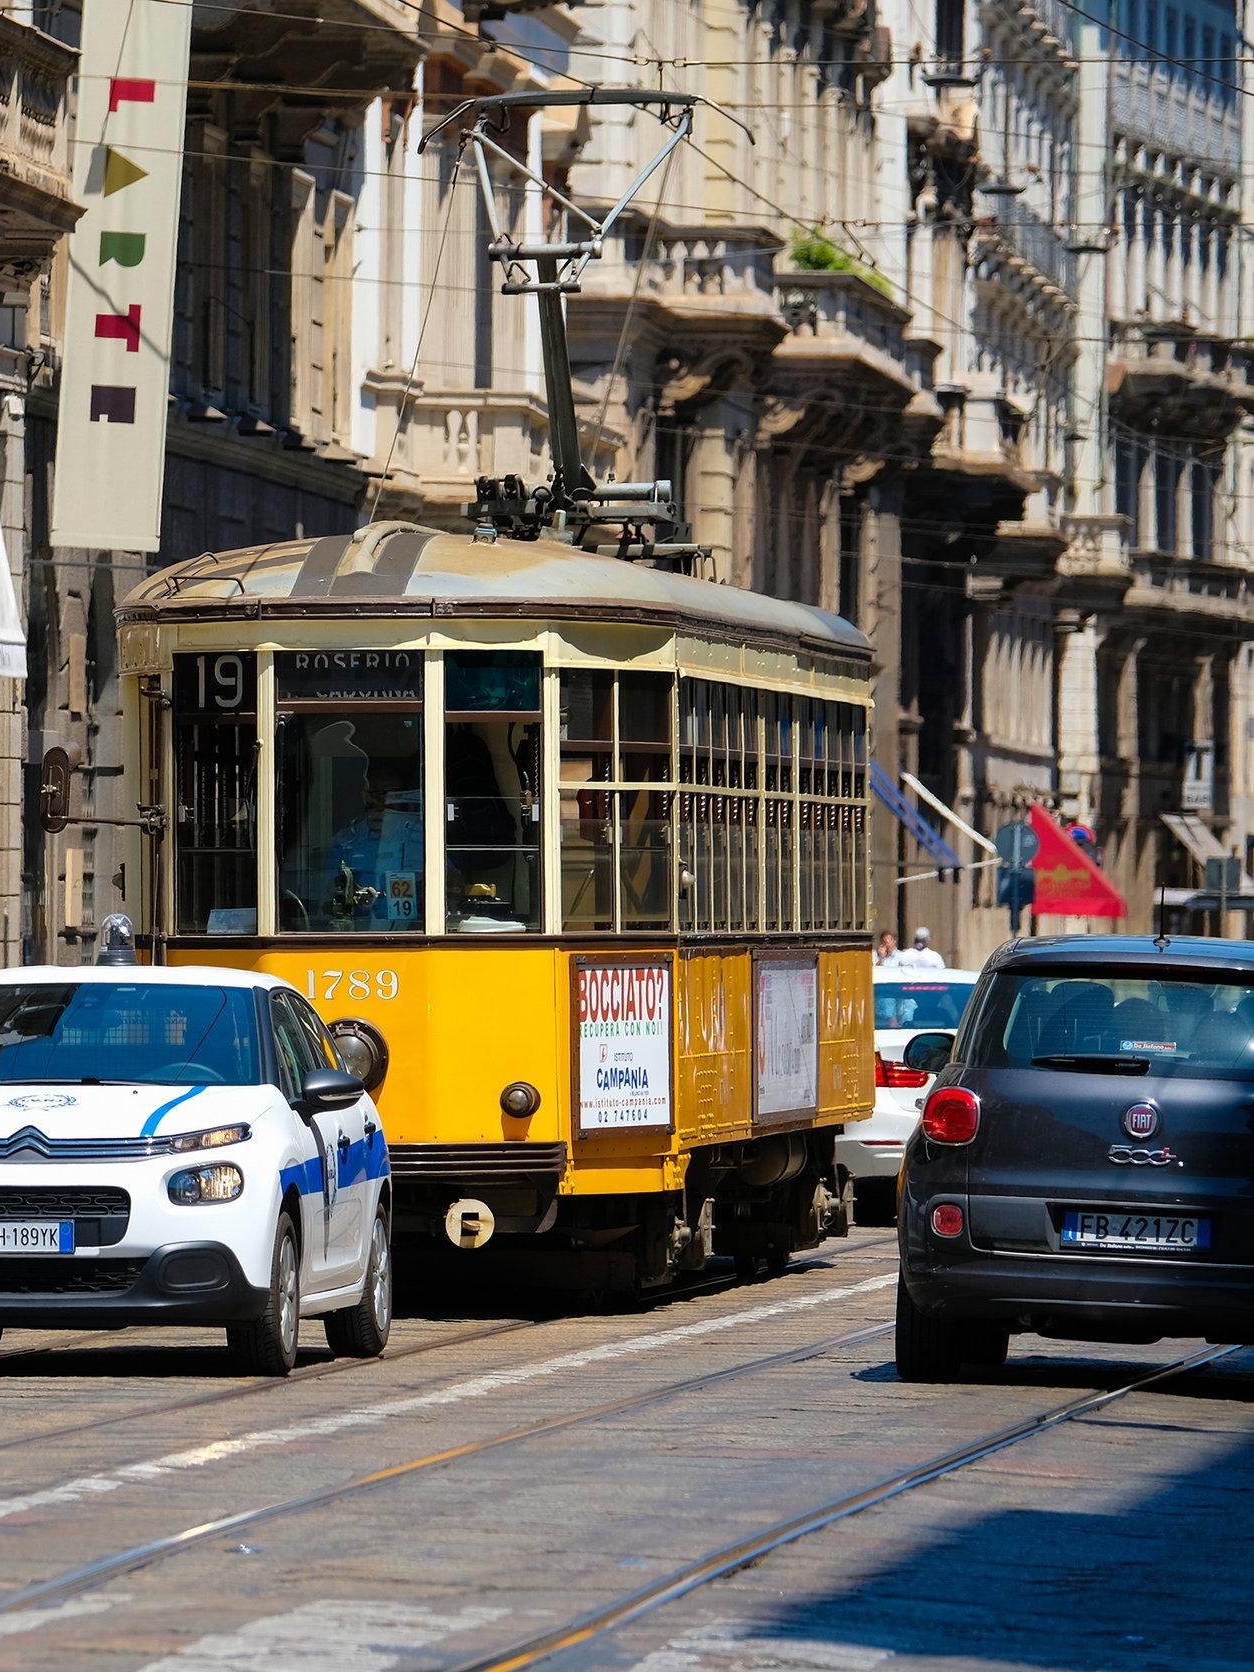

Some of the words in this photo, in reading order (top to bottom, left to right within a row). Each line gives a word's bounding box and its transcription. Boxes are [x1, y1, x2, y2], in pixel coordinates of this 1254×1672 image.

[196, 654, 244, 709] 19
[391, 881, 412, 898] 62
[393, 900, 412, 916] 19
[306, 969, 400, 1001] 1789
[579, 966, 664, 1023] BOCCIATO?
[581, 1022, 622, 1038] ECUPERA
[624, 1021, 642, 1037] CON
[598, 1110, 609, 1123] 02
[614, 1108, 649, 1122] 747604
[1132, 1113, 1152, 1129] FIAT
